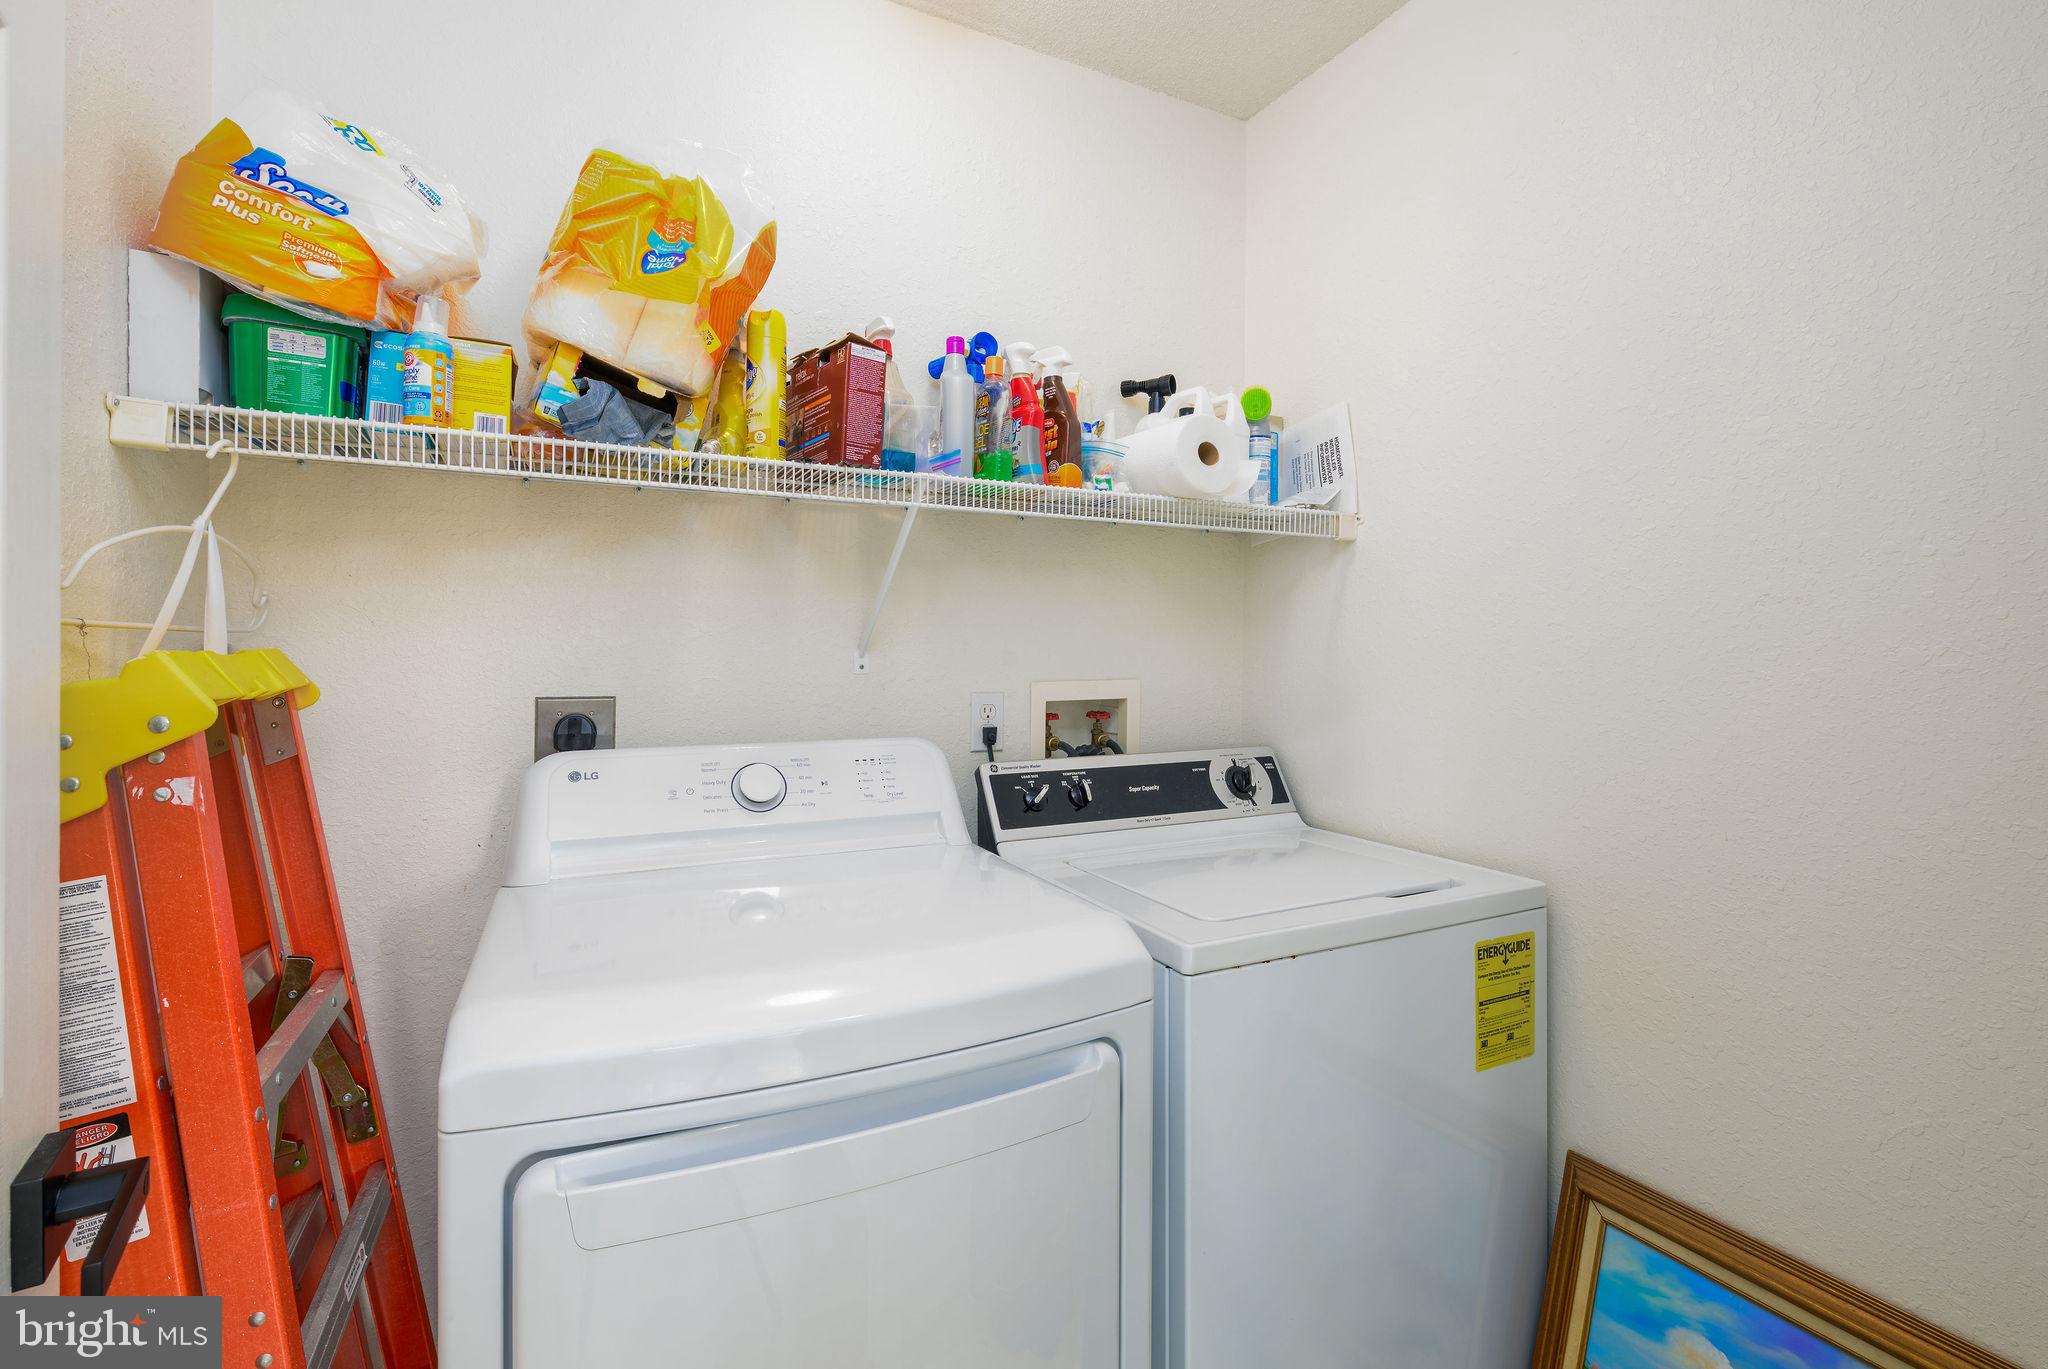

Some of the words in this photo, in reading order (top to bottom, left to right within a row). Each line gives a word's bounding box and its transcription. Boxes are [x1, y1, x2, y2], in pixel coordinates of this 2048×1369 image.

[212, 194, 260, 225] Plus
[219, 180, 314, 231] Comfort
[283, 232, 337, 260] Premium
[648, 253, 685, 264] Home
[646, 262, 675, 270] Total
[383, 343, 404, 351] ecos
[1320, 443, 1328, 484] INFORMATION
[584, 772, 599, 780] LG
[1477, 939, 1531, 960] ENERGYGUIDE
[76, 1125, 108, 1139] ANGER
[76, 1131, 110, 1145] ELIGRO
[77, 1225, 100, 1235] INSTRUCC
[73, 1232, 96, 1243] ESCALERA
